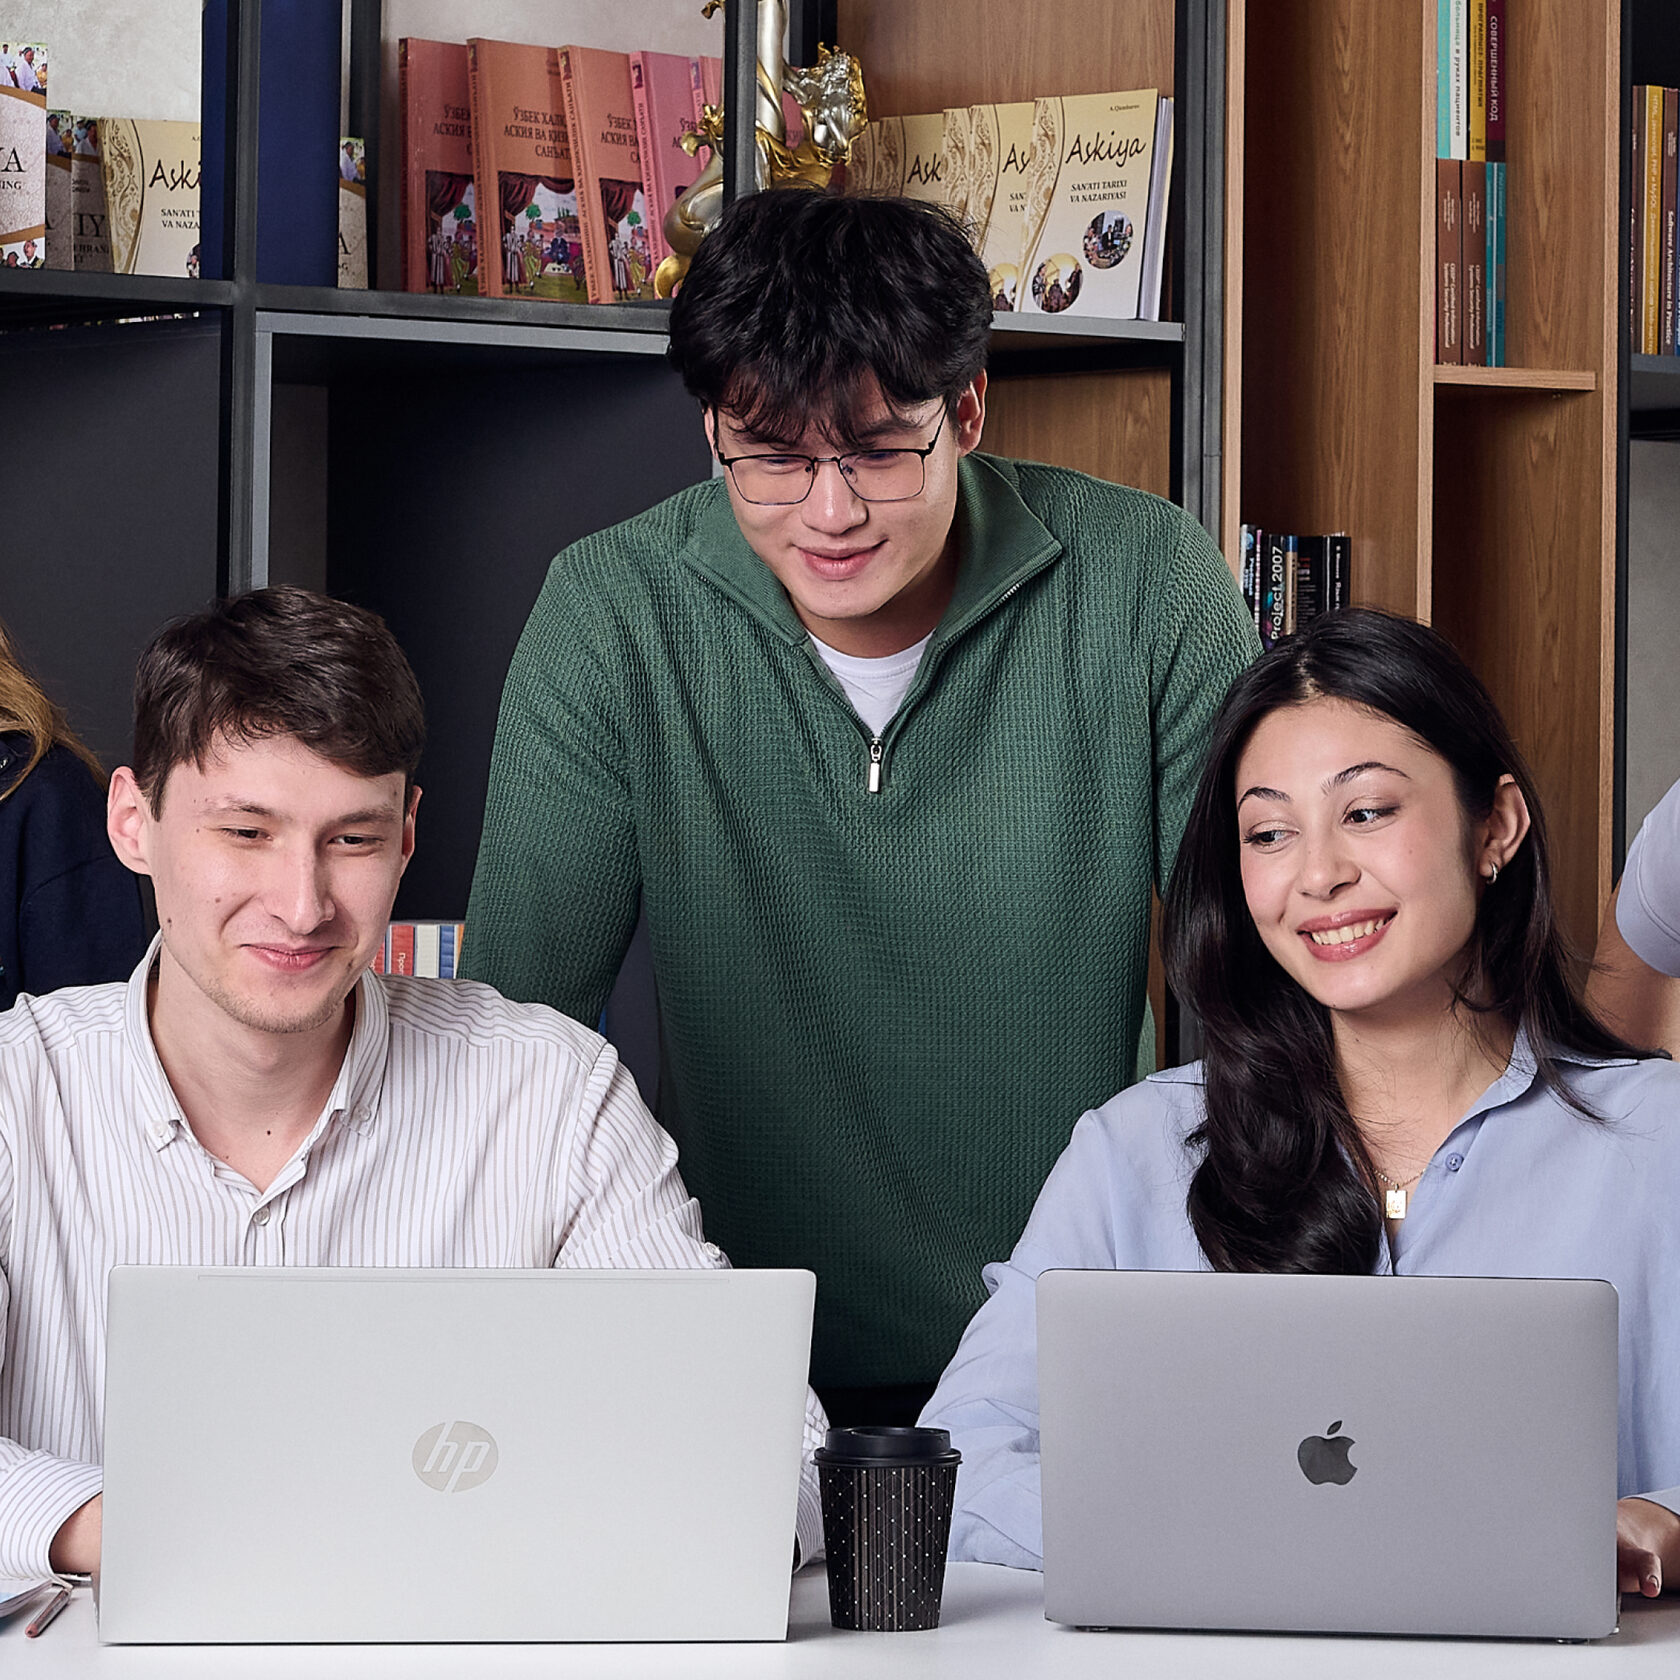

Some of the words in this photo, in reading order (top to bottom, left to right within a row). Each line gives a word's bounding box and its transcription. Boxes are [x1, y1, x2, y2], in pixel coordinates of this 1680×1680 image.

[1490, 15, 1500, 97] СОВЕРШЕННЫЙ
[1454, 85, 1462, 136] пациентов
[1489, 99, 1499, 122] КОД
[503, 123, 534, 140] АСКИЯ
[535, 128, 548, 142] ВА
[600, 131, 627, 145] АСКИЯ
[1064, 130, 1147, 168] Askiya
[1069, 195, 1085, 203] VA
[1085, 191, 1127, 203] NAZARIYASI
[1101, 179, 1128, 190] TARIXI
[161, 220, 174, 229] VA
[1667, 210, 1675, 247] Software
[1666, 247, 1674, 300] Architecture
[1666, 300, 1674, 310] in
[1665, 310, 1673, 345] Practice
[1271, 546, 1283, 582] 2007
[1270, 585, 1284, 639] Project
[422, 1421, 491, 1492] hp
